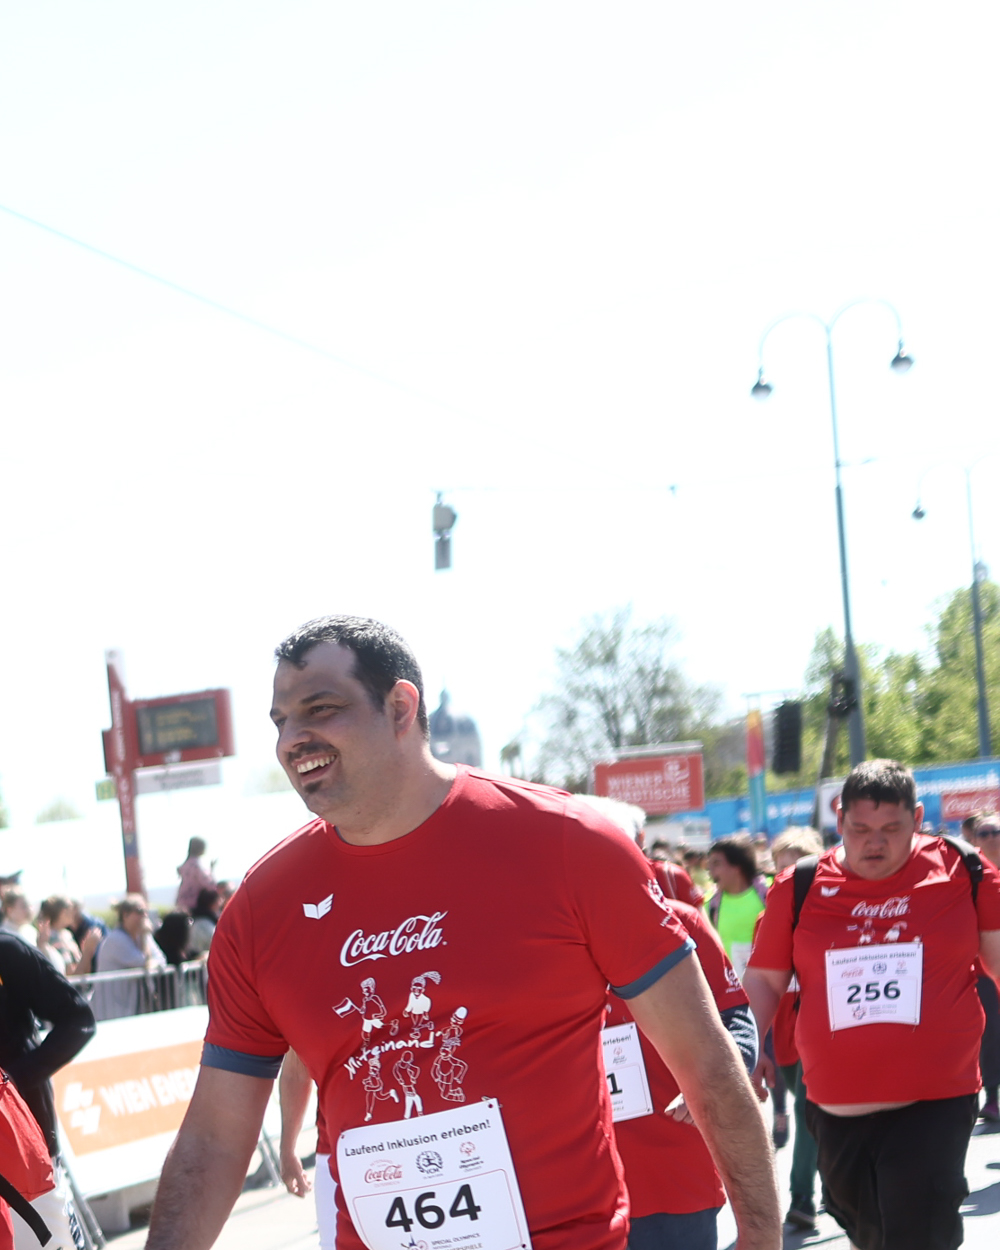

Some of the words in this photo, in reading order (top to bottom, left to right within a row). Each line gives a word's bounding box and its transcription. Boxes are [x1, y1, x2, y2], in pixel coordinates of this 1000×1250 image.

[851, 894, 911, 919] Coca-Cola
[340, 910, 449, 967] Coca-Cola
[847, 980, 901, 1004] 256
[101, 1077, 157, 1116] WIEN
[345, 1142, 385, 1157] Laufend
[386, 1132, 438, 1151] Inklusion
[440, 1119, 491, 1140] erleben!
[385, 1183, 481, 1233] 464
